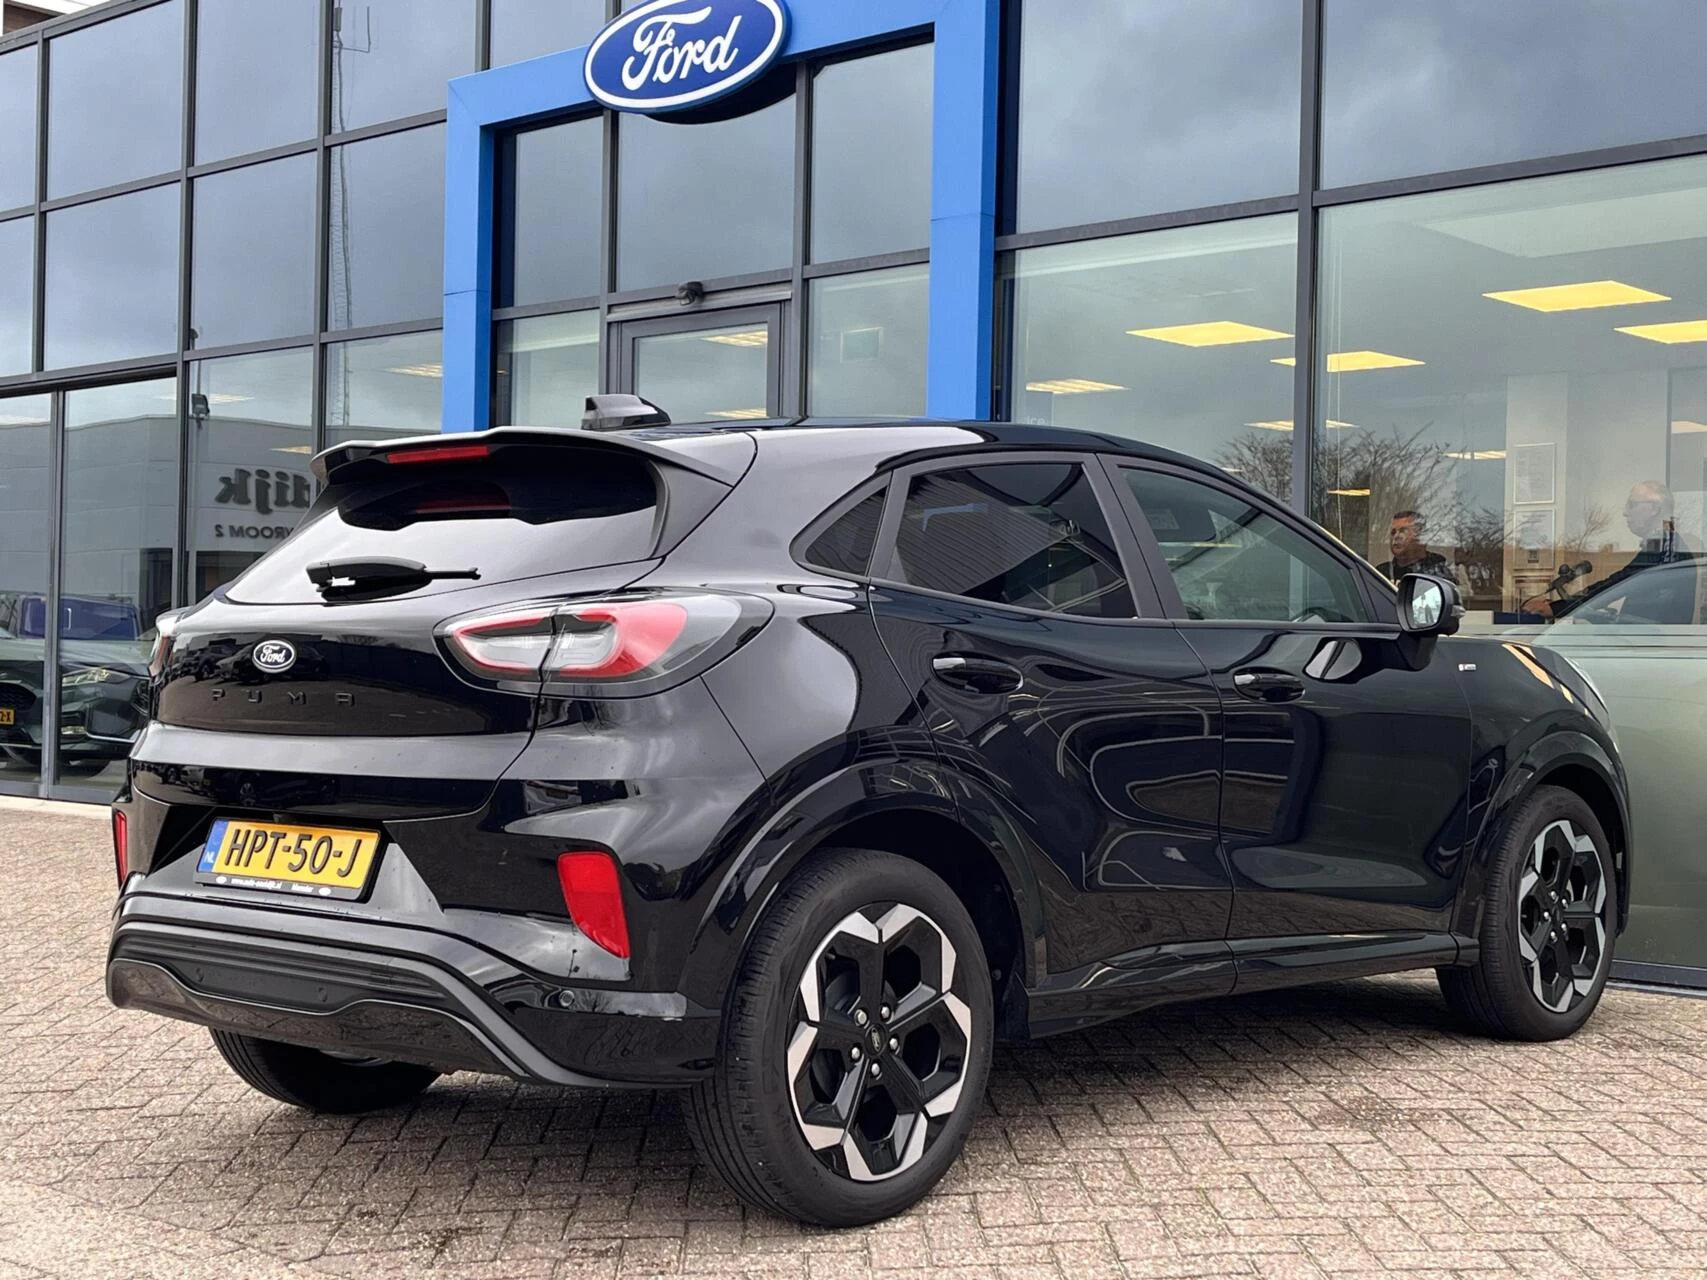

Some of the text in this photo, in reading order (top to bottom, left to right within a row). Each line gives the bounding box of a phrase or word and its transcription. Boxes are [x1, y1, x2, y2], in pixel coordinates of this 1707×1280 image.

[621, 6, 742, 91] Ford
[260, 644, 286, 663] Ford
[211, 687, 355, 706] PUMA
[203, 851, 214, 863] NL
[224, 829, 362, 878] HPT-50-J
